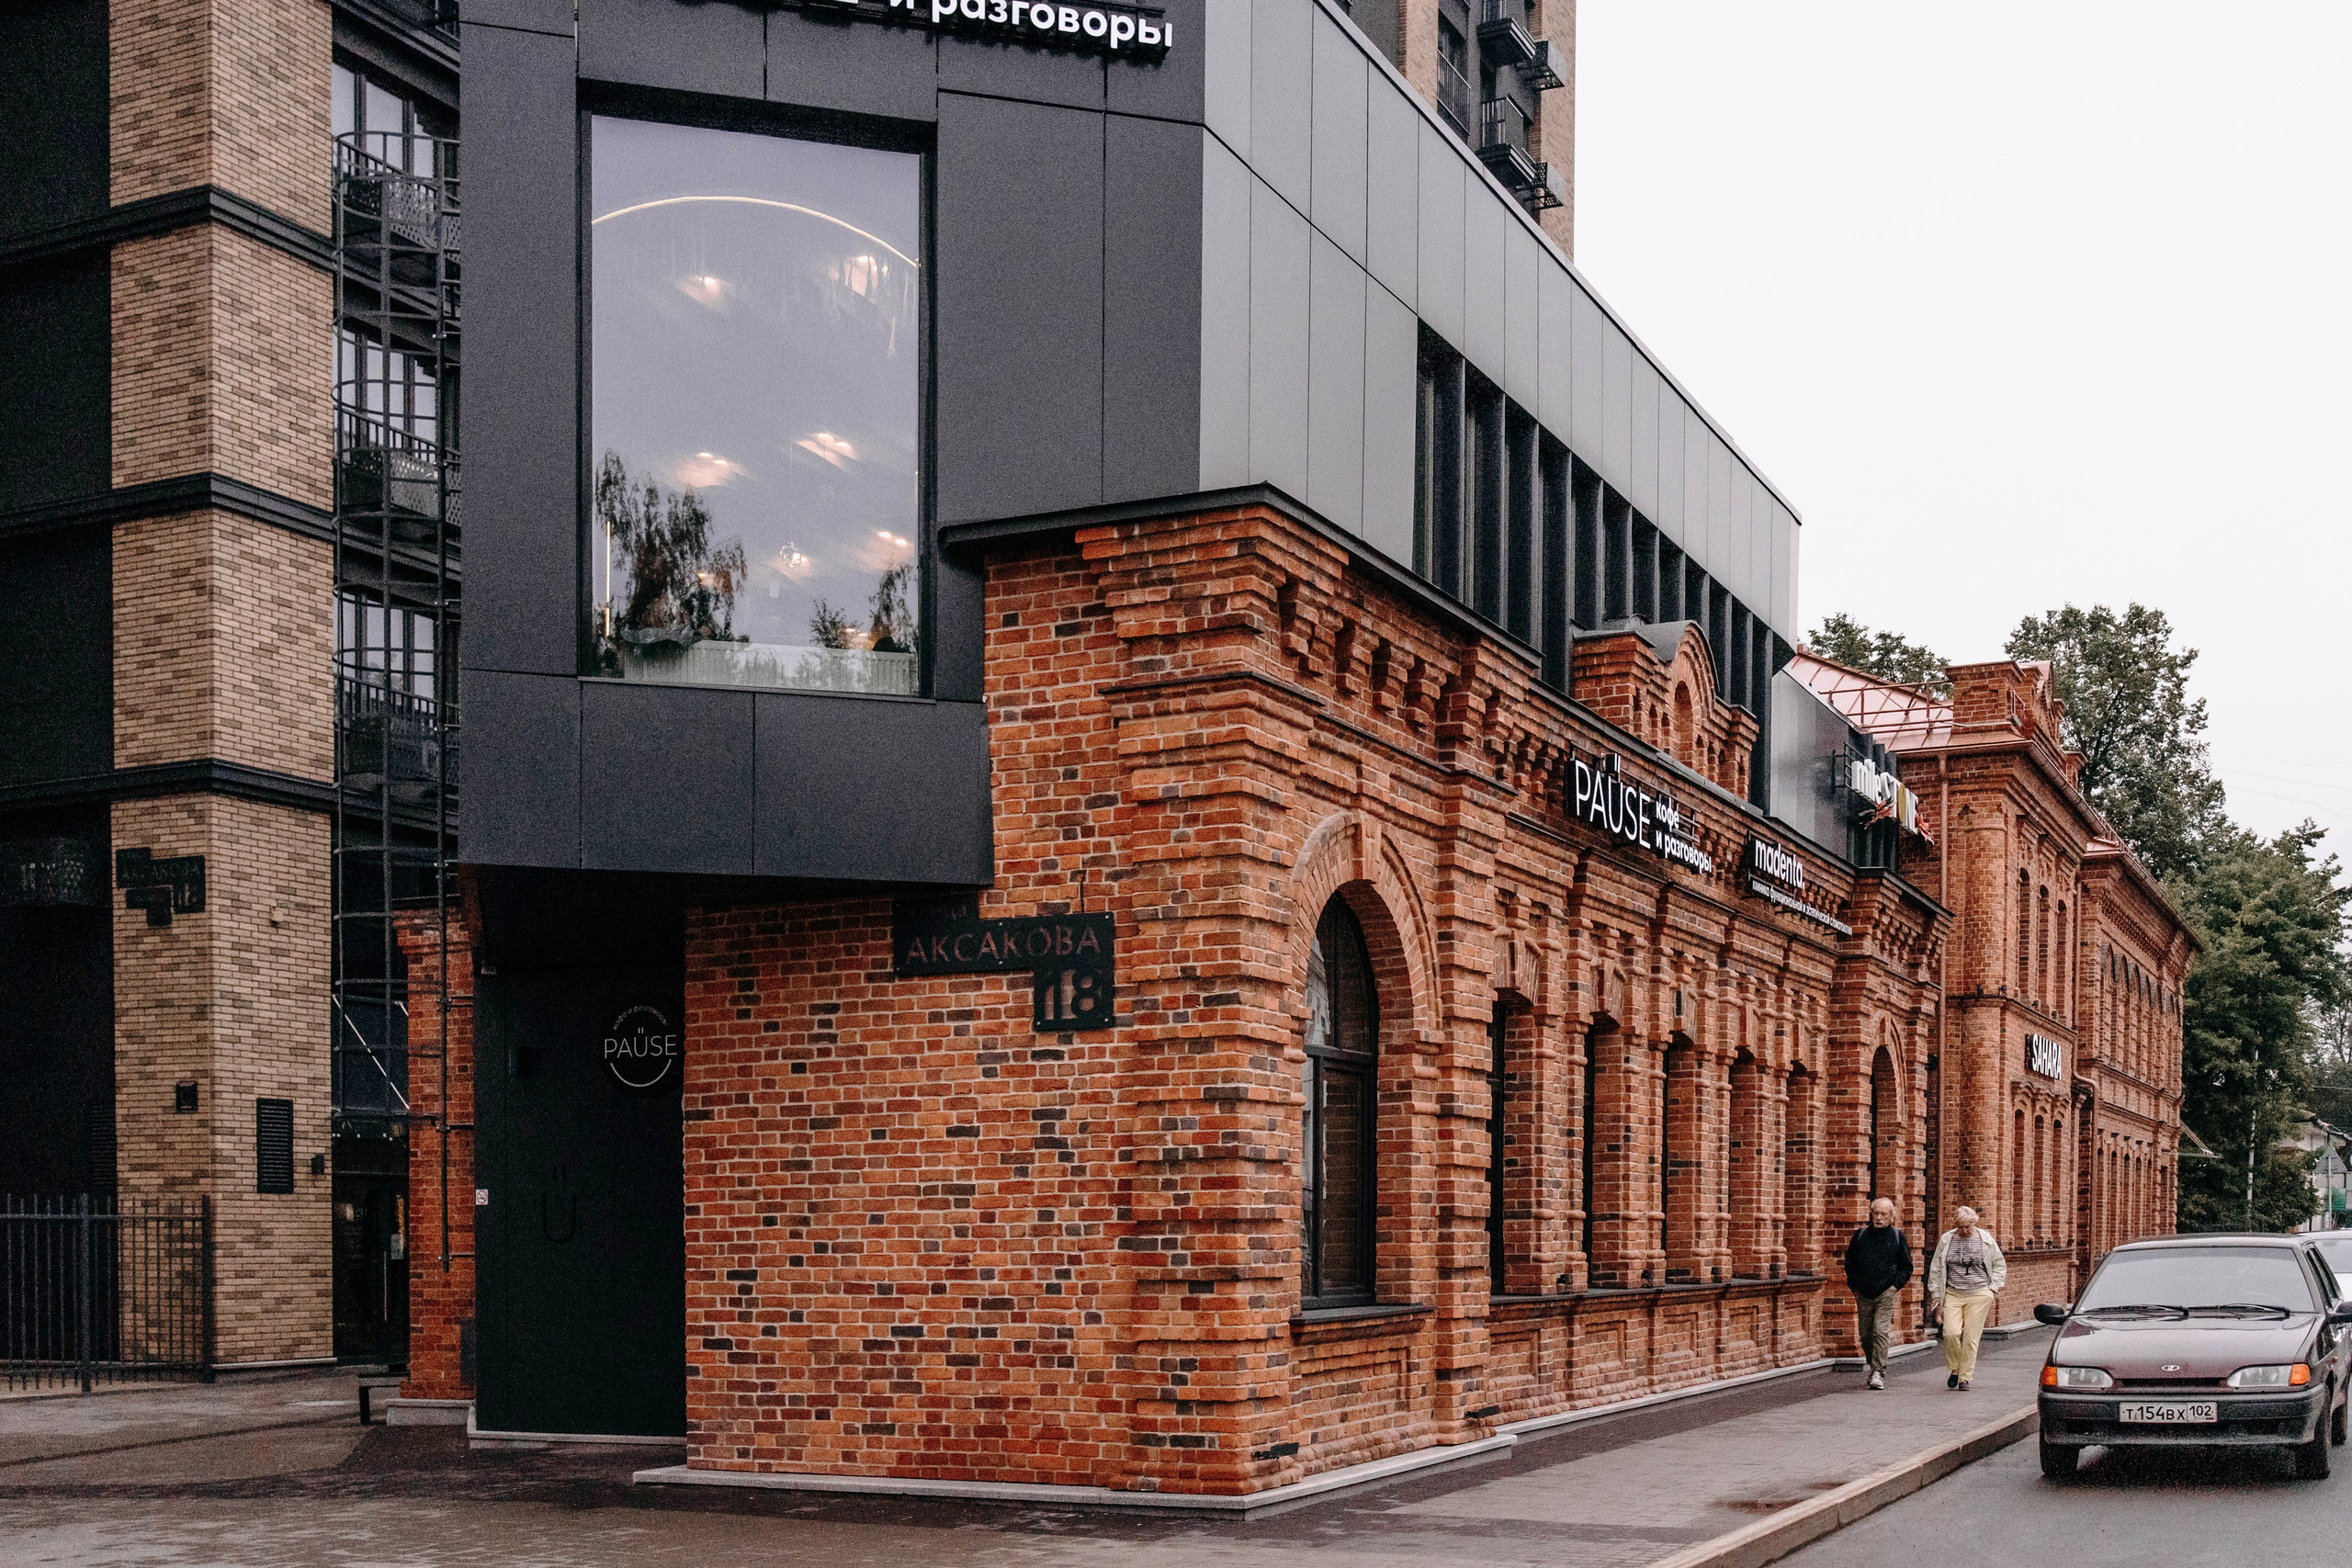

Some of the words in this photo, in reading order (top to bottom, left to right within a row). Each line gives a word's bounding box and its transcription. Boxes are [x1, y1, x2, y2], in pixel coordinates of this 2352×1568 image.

[932, 0, 1173, 50] разговоры
[1656, 796, 1679, 832] кофе
[1656, 830, 1663, 849] и
[1664, 834, 1712, 874] разговоры
[905, 925, 1102, 965] АКСАКОВА
[1044, 967, 1102, 1021] 18
[2032, 1033, 2062, 1081] SAHARA
[2188, 1404, 2212, 1416] 102
